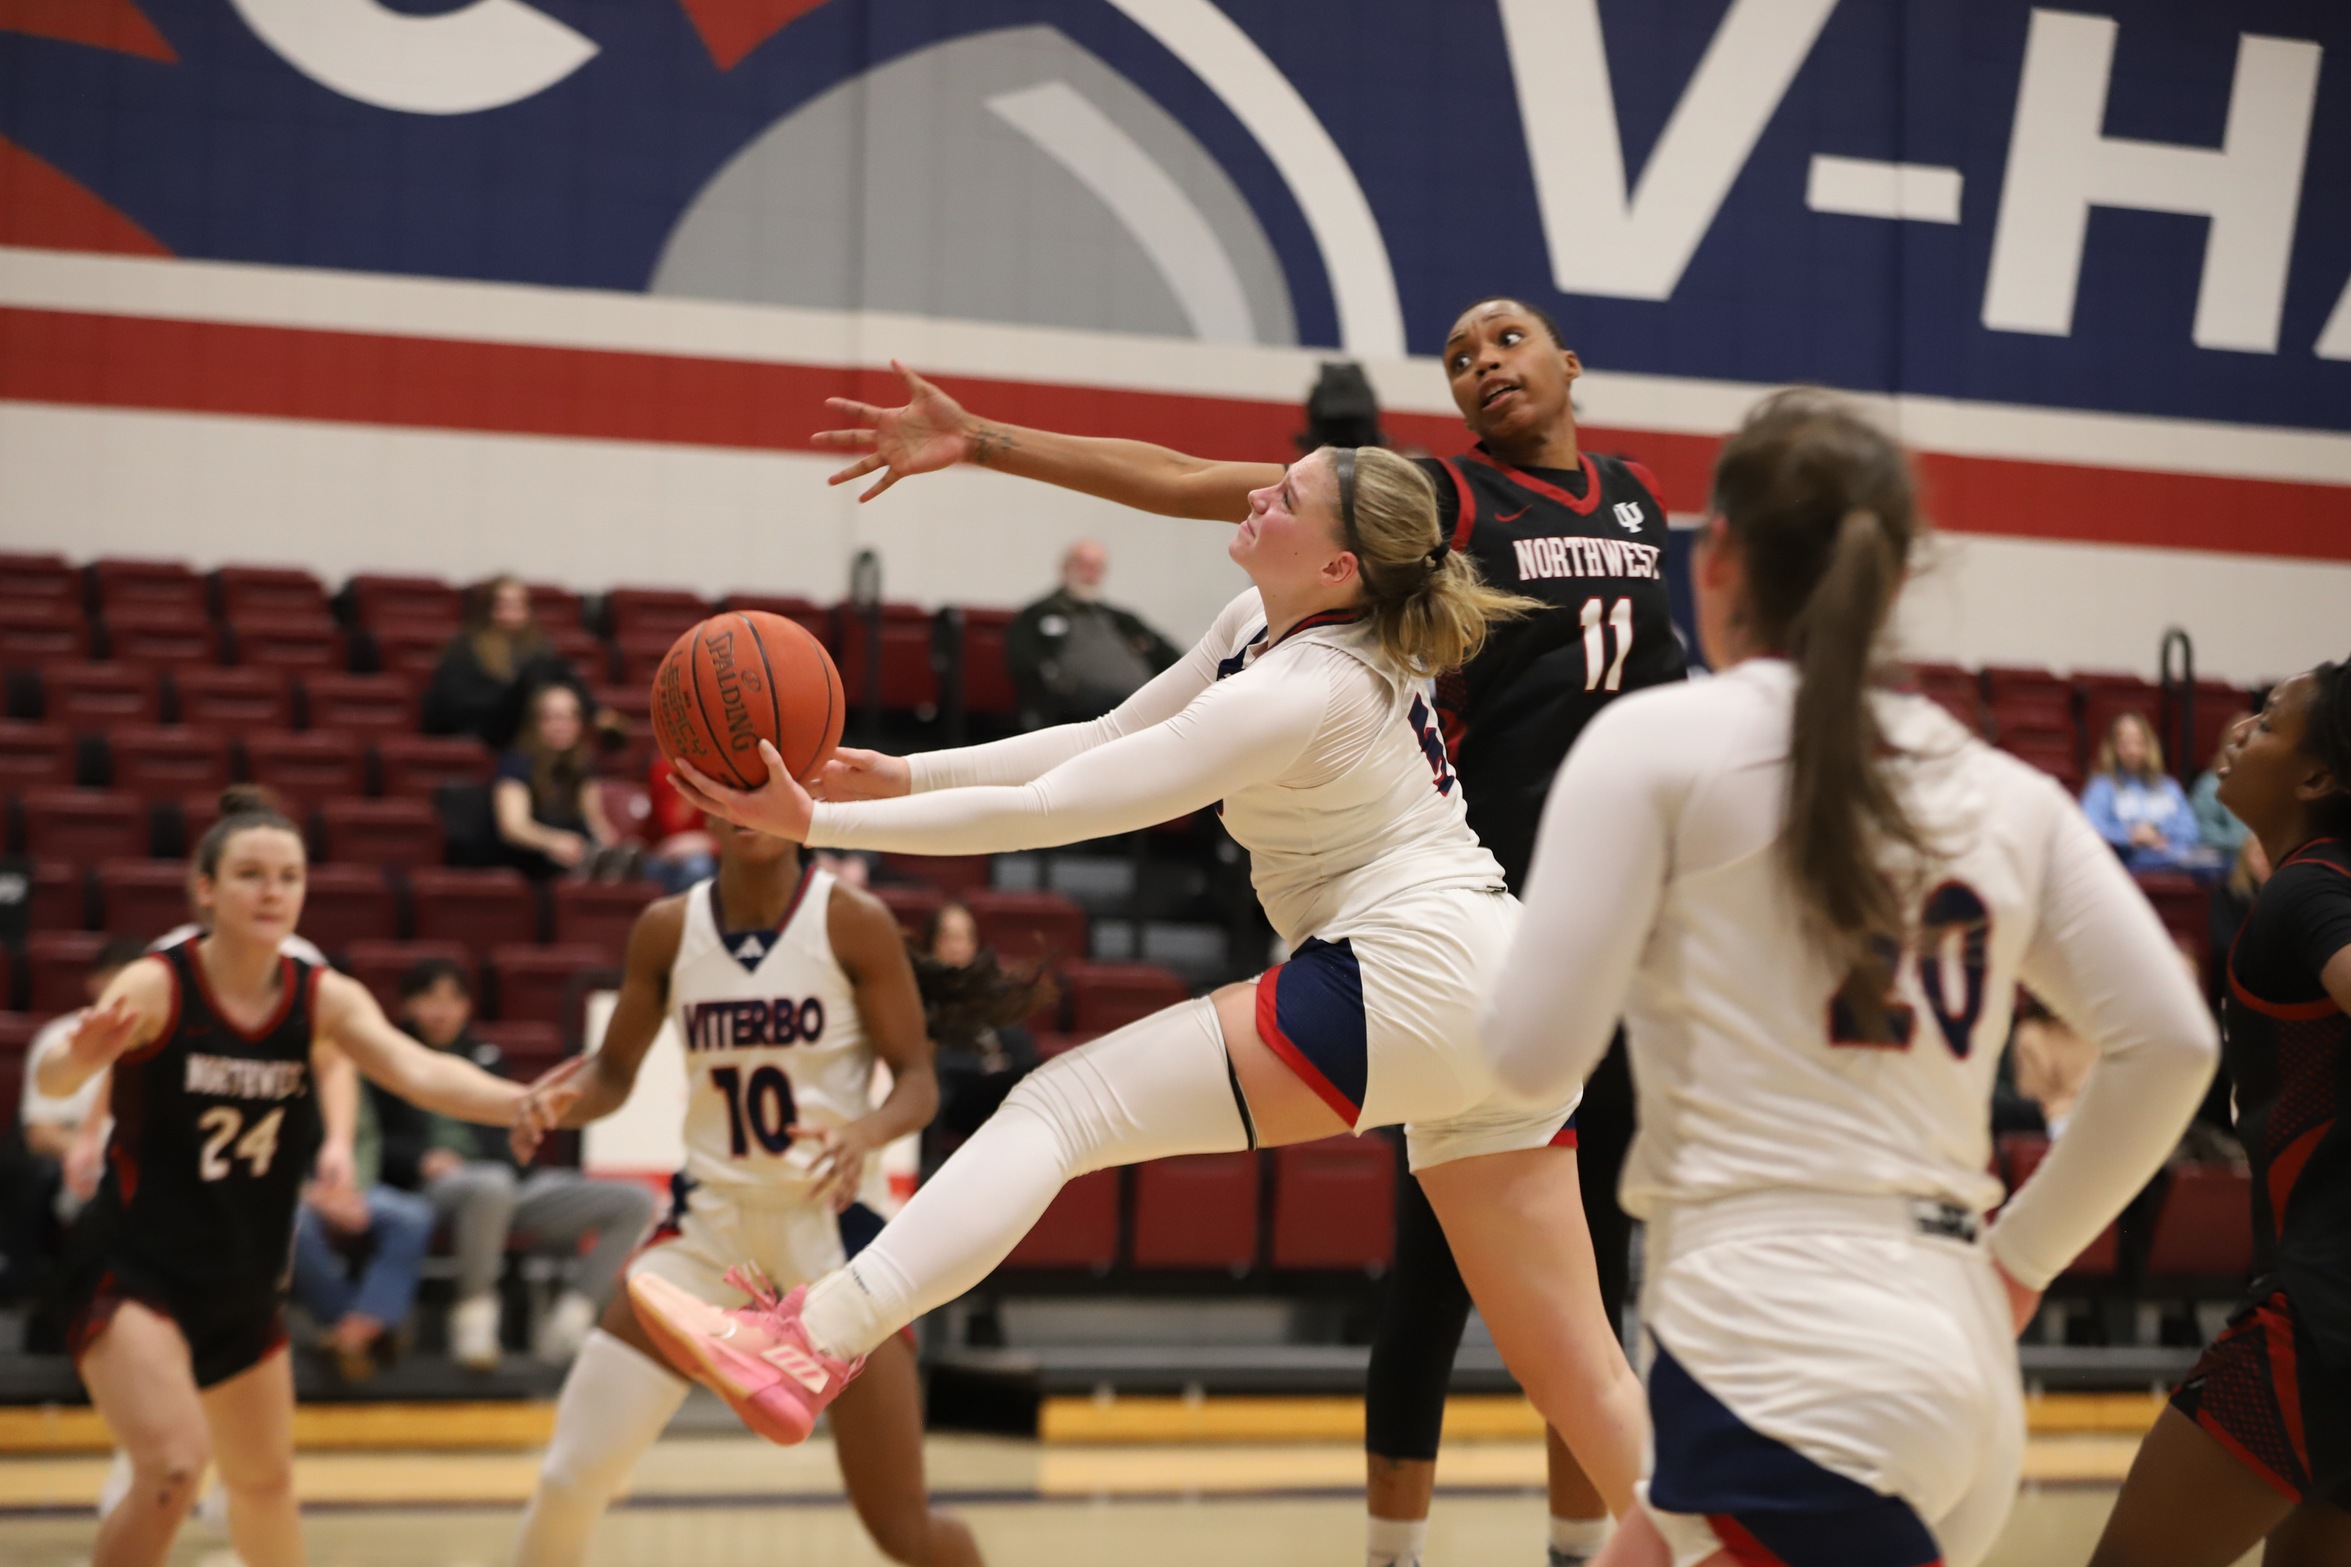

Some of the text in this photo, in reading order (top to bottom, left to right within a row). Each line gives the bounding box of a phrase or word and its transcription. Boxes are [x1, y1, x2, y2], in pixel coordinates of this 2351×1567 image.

[1498, 0, 2351, 361] V-H
[705, 631, 761, 752] SPALDING
[1580, 596, 1633, 692] 11
[684, 997, 825, 1052] VITERBO
[197, 1104, 287, 1182] 24
[710, 1064, 797, 1159] 10
